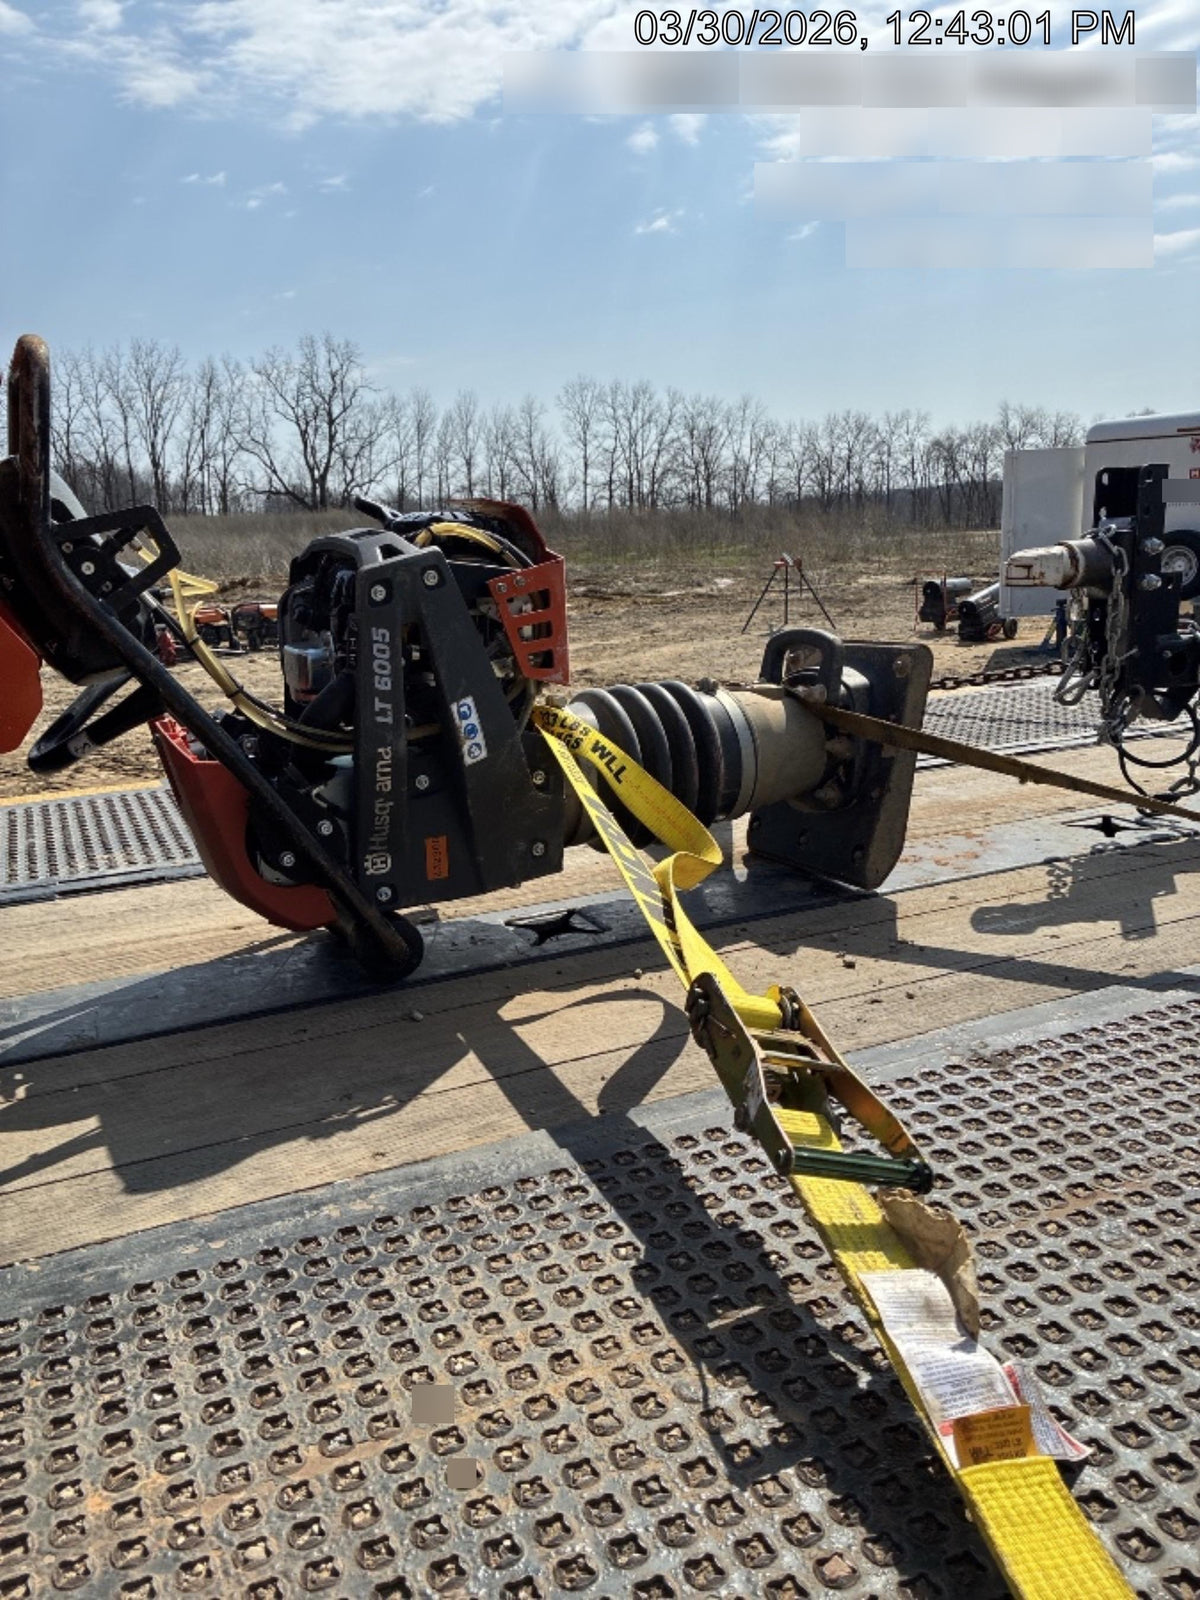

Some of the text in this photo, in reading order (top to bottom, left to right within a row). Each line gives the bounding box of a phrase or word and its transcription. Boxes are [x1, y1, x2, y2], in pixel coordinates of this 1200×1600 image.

[369, 627, 394, 850] Husqarna LT 6005
[560, 716, 591, 736] LBS
[591, 740, 626, 784] WLL
